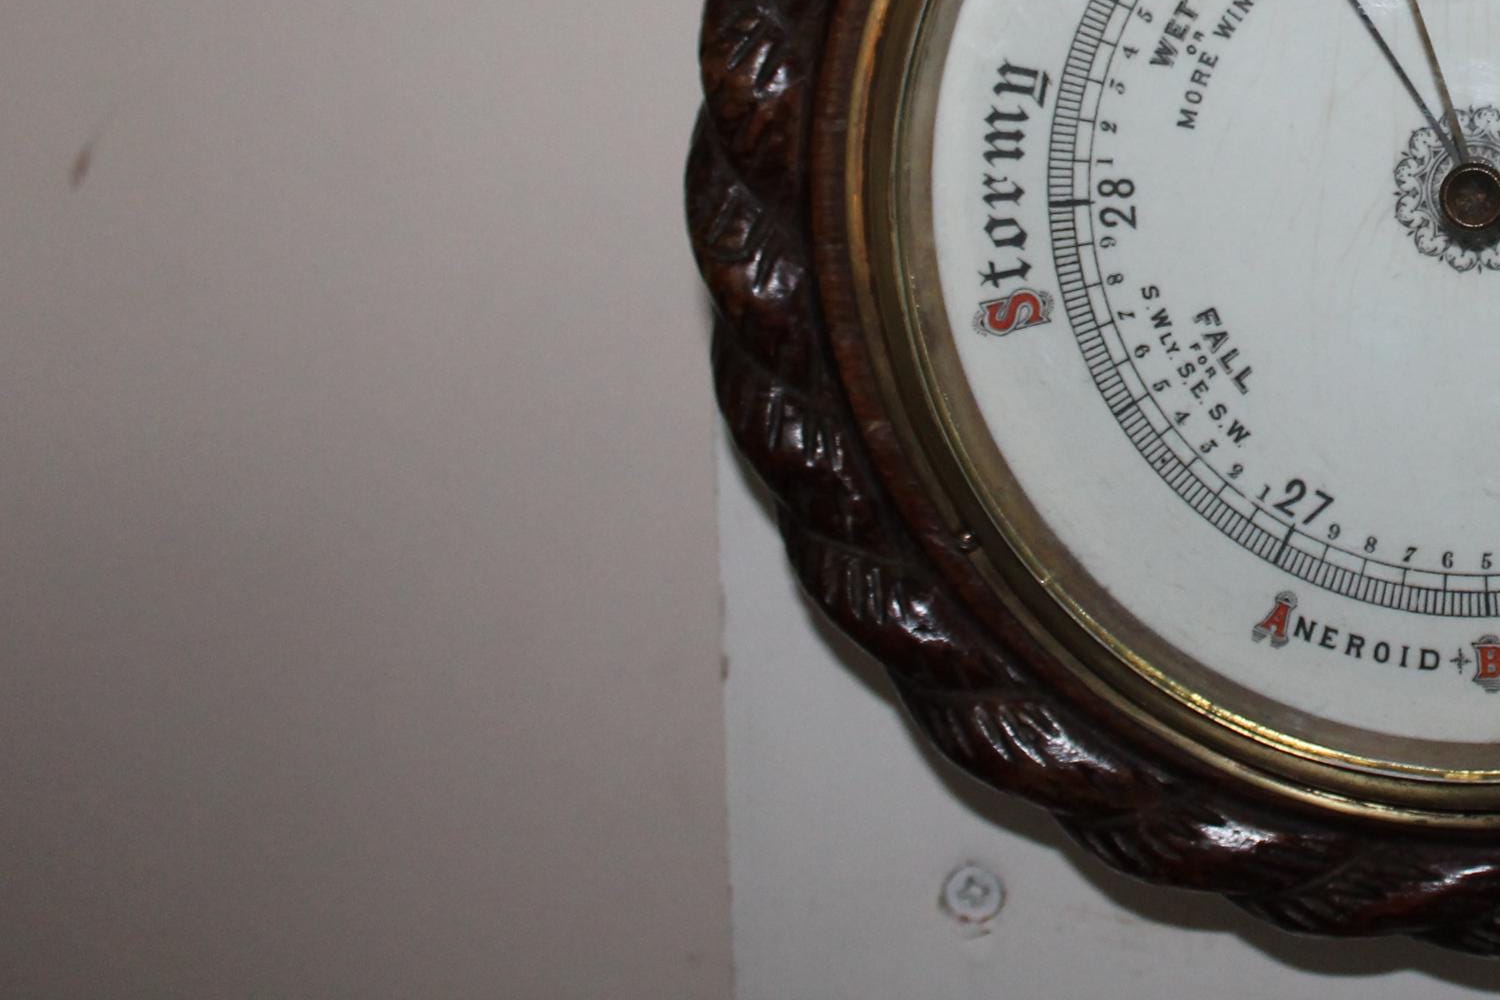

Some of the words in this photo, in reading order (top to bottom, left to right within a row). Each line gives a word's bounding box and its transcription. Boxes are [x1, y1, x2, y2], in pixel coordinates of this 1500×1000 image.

[1137, 8, 1153, 23] 5
[1187, 30, 1205, 55] OR
[1122, 46, 1138, 60] 4
[1109, 78, 1126, 95] 3
[1178, 54, 1218, 130] MORE
[1101, 121, 1118, 134] 2
[1097, 158, 1114, 167] 1
[978, 58, 1051, 336] Stormy
[1099, 177, 1137, 229] 28
[1101, 237, 1117, 248] 9
[1107, 274, 1123, 285] 8
[1118, 311, 1134, 322] 7
[1133, 345, 1149, 358] 6
[1194, 308, 1252, 395] FALL
[1190, 343, 1218, 379] FOR
[1153, 382, 1170, 393] 5
[1174, 411, 1189, 426] 4
[1200, 438, 1218, 454] 3
[1228, 463, 1244, 479] 2
[1259, 486, 1270, 502] 1
[1274, 478, 1335, 525] 27
[1328, 523, 1342, 539] 9
[1364, 537, 1377, 552] 8
[1403, 547, 1417, 562] 7
[1443, 552, 1454, 568] 6
[1481, 552, 1492, 568] 5
[1252, 592, 1441, 671] ANEROID
